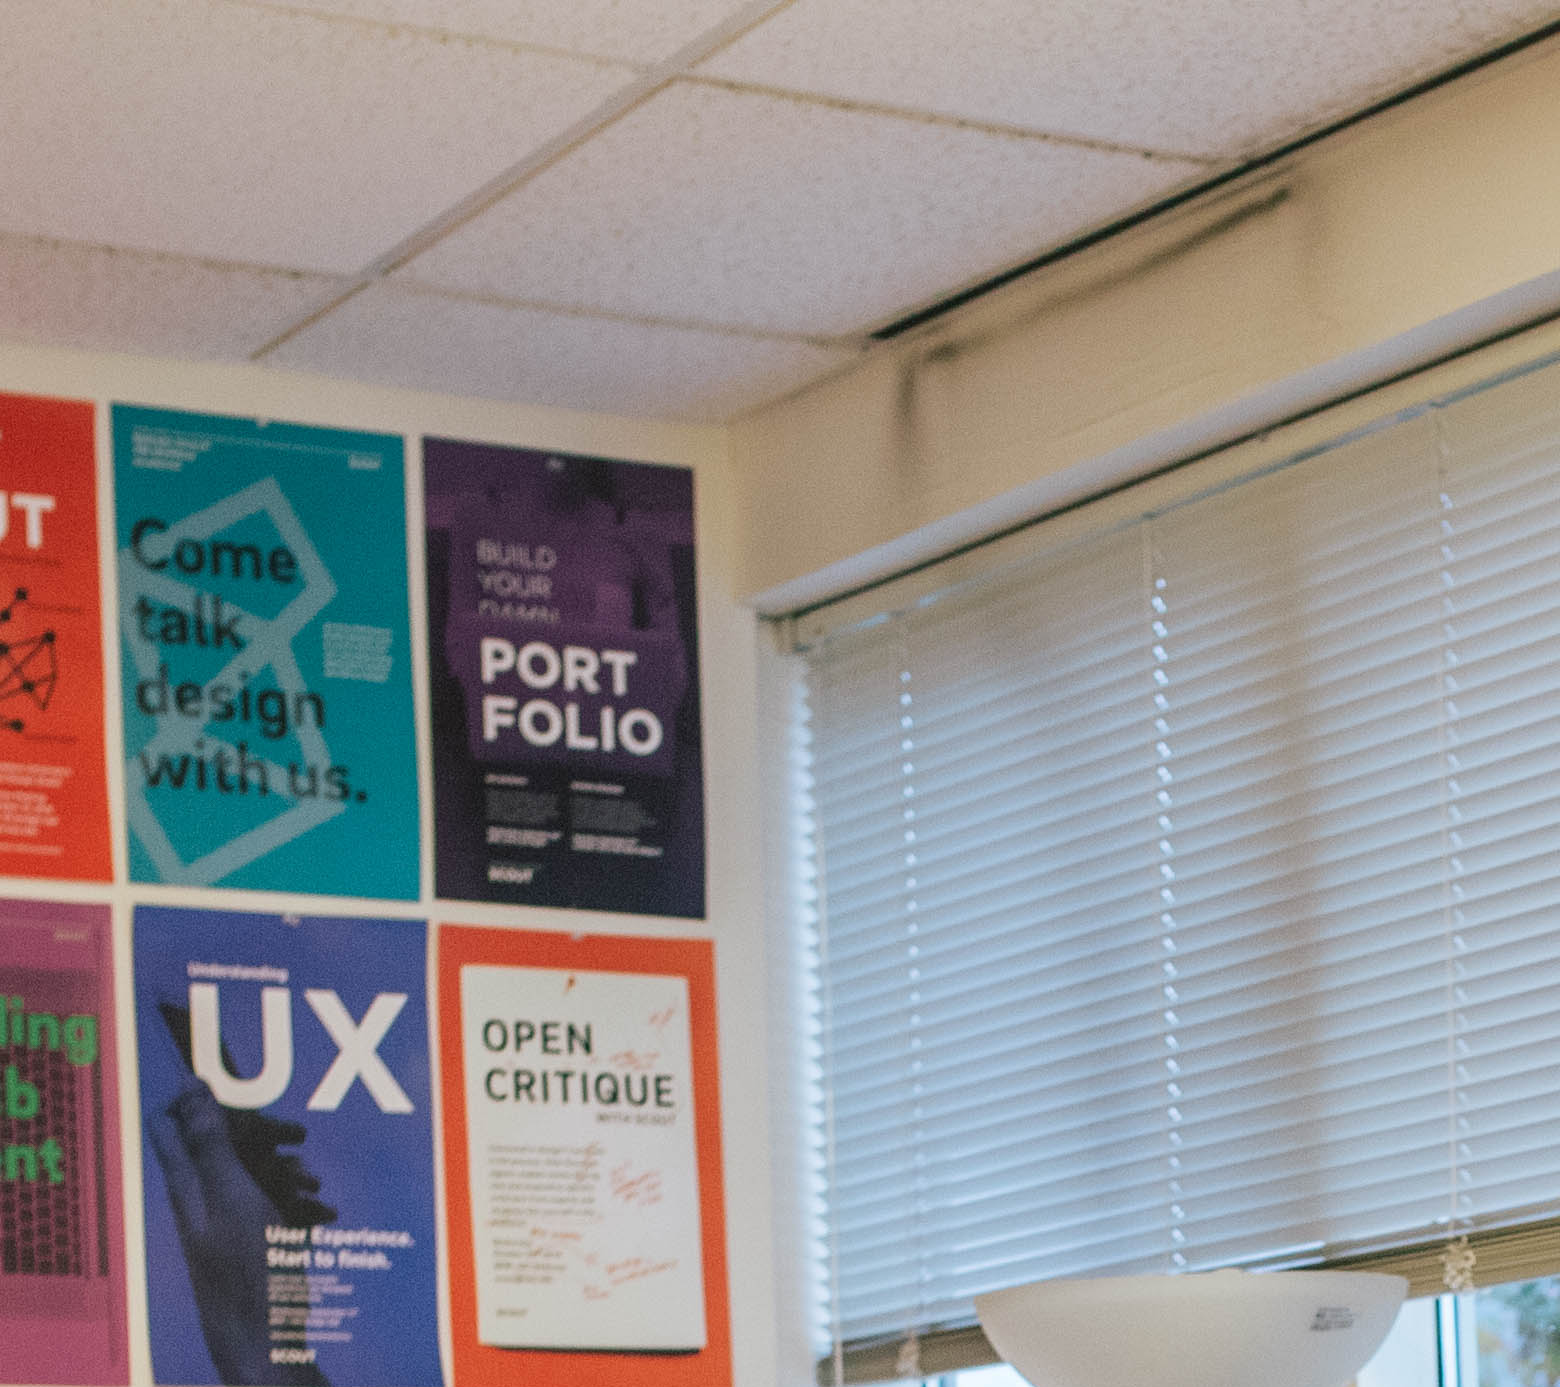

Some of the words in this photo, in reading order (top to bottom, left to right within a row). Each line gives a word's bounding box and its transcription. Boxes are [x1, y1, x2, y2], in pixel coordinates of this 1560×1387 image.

[129, 518, 299, 586] Come
[476, 538, 557, 571] BUILD
[476, 570, 553, 600] YOUR
[135, 590, 246, 652] talk
[480, 637, 638, 697] PORT
[134, 663, 327, 741] design
[482, 694, 664, 757] FOLIO
[140, 739, 274, 796] with
[284, 760, 369, 804] us.
[189, 982, 415, 1115] UX
[481, 1017, 594, 1055] OPEN
[484, 1067, 677, 1109] CRITIQUE
[266, 1224, 308, 1246] User
[312, 1226, 416, 1250] Experience.
[267, 1246, 311, 1270] Start
[315, 1249, 335, 1270] to
[338, 1249, 392, 1271] finish.
